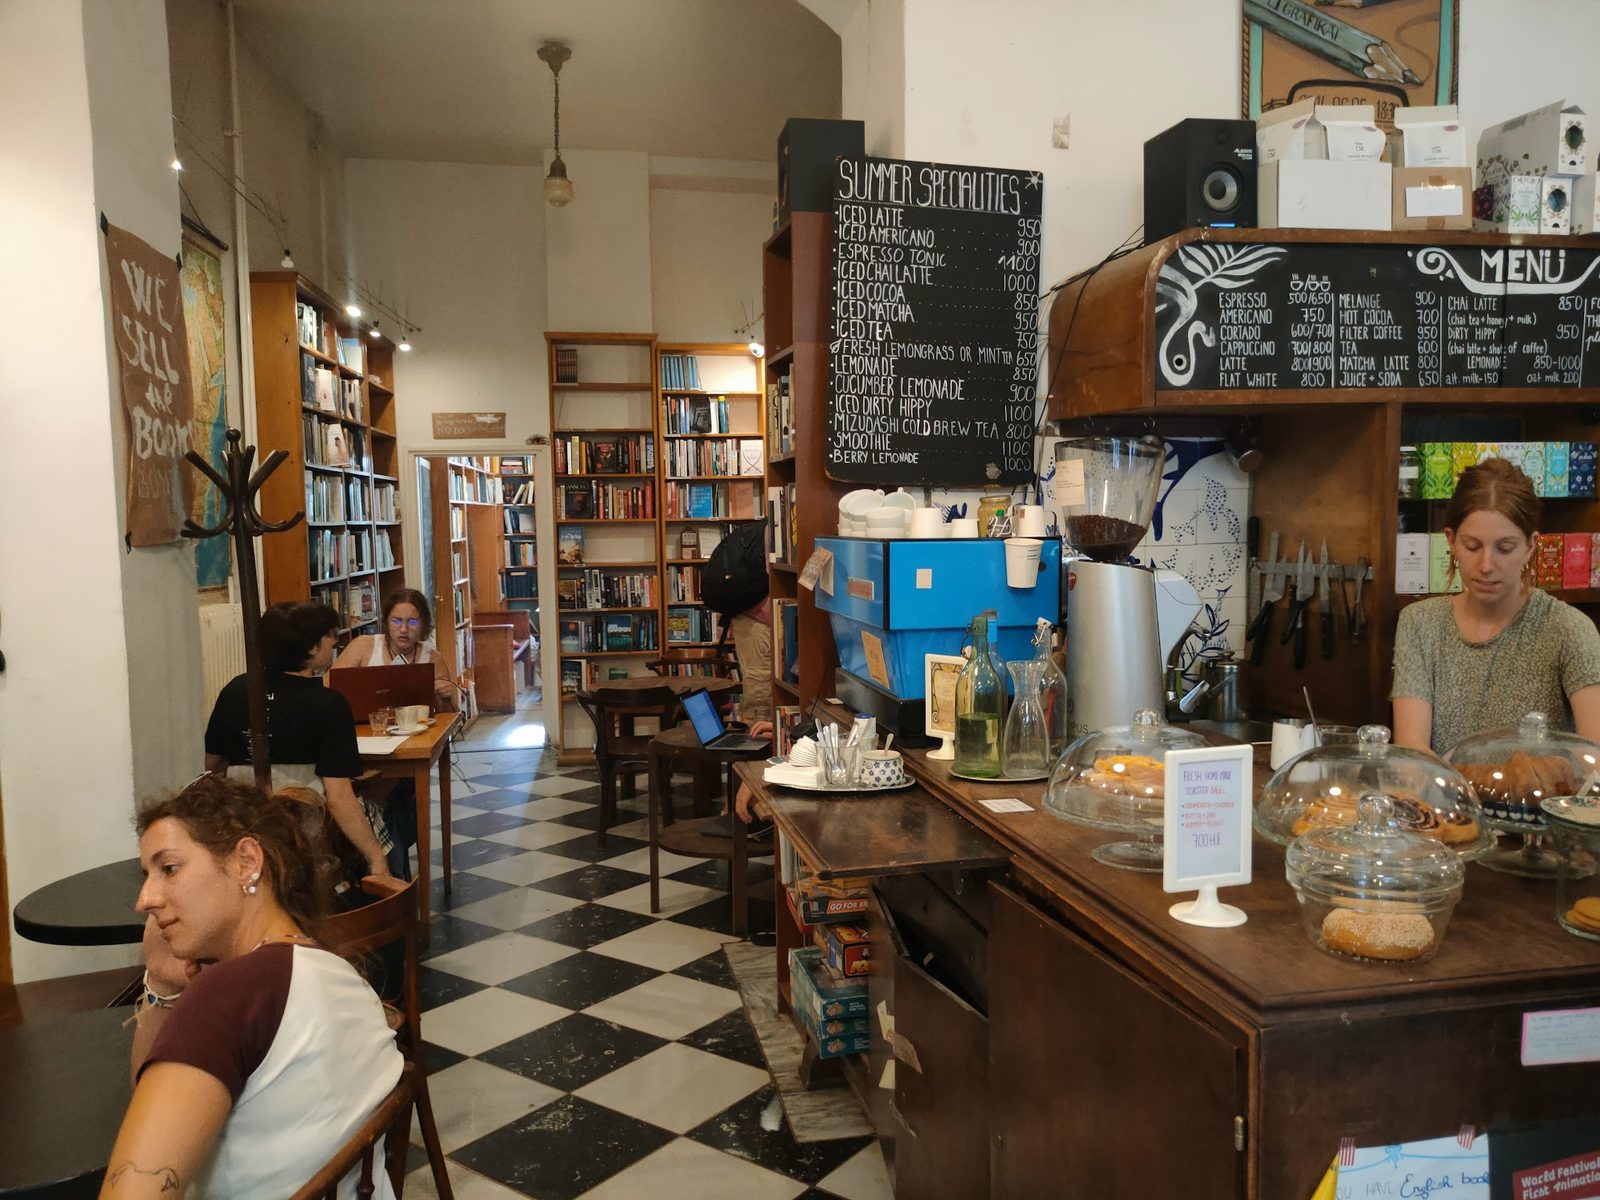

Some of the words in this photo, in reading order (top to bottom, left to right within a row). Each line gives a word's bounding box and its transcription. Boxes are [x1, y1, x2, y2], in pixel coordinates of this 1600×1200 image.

[840, 160, 912, 204] SUMMER
[917, 168, 1020, 214] SPECIALITIES
[839, 205, 866, 224] ICED
[870, 208, 904, 227] LATTE
[1018, 219, 1041, 238] 950
[839, 224, 866, 242] ICED
[869, 228, 934, 247] AMERICANO
[1017, 240, 1039, 256] 900
[838, 243, 903, 263] ESPRESSO
[910, 249, 946, 267] TONIC
[838, 261, 865, 280] ICED
[867, 262, 892, 282] CHAI
[896, 265, 934, 285] LATTE
[1003, 274, 1035, 291] 1000
[121, 259, 172, 333] WE
[837, 280, 865, 300] ICED
[866, 283, 905, 303] COCOA
[1014, 295, 1038, 310] 850
[1219, 293, 1267, 308] ESPRESSO
[1288, 293, 1330, 304] 500/650
[1339, 294, 1380, 308] MELANGE
[1416, 291, 1435, 305] 900
[1474, 298, 1497, 310] LATTE
[1558, 296, 1582, 310] 850
[837, 300, 865, 319] ICED
[868, 303, 914, 323] MATCHA
[1014, 313, 1037, 330] 950
[1301, 308, 1324, 322] 750
[1340, 310, 1358, 325] HOT
[1364, 310, 1394, 325] COCOA
[1416, 309, 1439, 324] 700
[837, 320, 865, 339] ICED
[867, 322, 893, 341] TEA
[1017, 332, 1037, 349] 750
[1220, 326, 1261, 340] CORTADO
[1291, 324, 1332, 338] 600/700
[1374, 326, 1402, 340] COFFEE
[1418, 327, 1438, 339] 950
[1556, 324, 1579, 339] 950
[121, 312, 179, 384] SELL
[843, 339, 880, 357] FRESH
[886, 342, 954, 361] LEMONGRASS
[960, 347, 972, 362] OR
[978, 348, 1002, 364] MINT
[1002, 351, 1013, 365] TEA
[1017, 352, 1037, 367] 650
[1341, 342, 1357, 355] TEA
[1418, 341, 1438, 354] 600
[1508, 341, 1517, 353] of
[835, 355, 897, 377] LEMONADE
[1013, 368, 1036, 381] 850
[1220, 357, 1247, 371] LATTE
[1340, 356, 1375, 370] MATCHA
[1384, 356, 1409, 370] LATTE
[1418, 355, 1438, 369] 800
[1534, 355, 1580, 370] 850-1000
[835, 375, 894, 396] CUCUMBER
[901, 378, 965, 400] LEMONADE
[1008, 384, 1035, 402] 900
[1219, 373, 1241, 387] FLAT
[1301, 373, 1325, 386] 800
[1378, 372, 1401, 386] SODA
[1419, 371, 1438, 386] 650
[1563, 372, 1578, 383] 200
[835, 395, 859, 414] ICED
[863, 397, 894, 416] DIRTY
[900, 399, 932, 418] HIPPY
[1005, 405, 1032, 422] 1100
[835, 414, 898, 434] MIZUDASHI
[903, 419, 930, 436] COLD
[934, 421, 971, 436] BREW
[975, 422, 999, 439] TEA
[1006, 425, 1032, 439] 800
[834, 432, 892, 450] SMOOTHIE
[1002, 441, 1030, 456] 1100
[834, 450, 868, 463] BERRY
[873, 452, 919, 464] LEMONADE
[1004, 457, 1031, 471] 1000
[1366, 1181, 1394, 1196] HAVE
[1401, 1174, 1453, 1199] English
